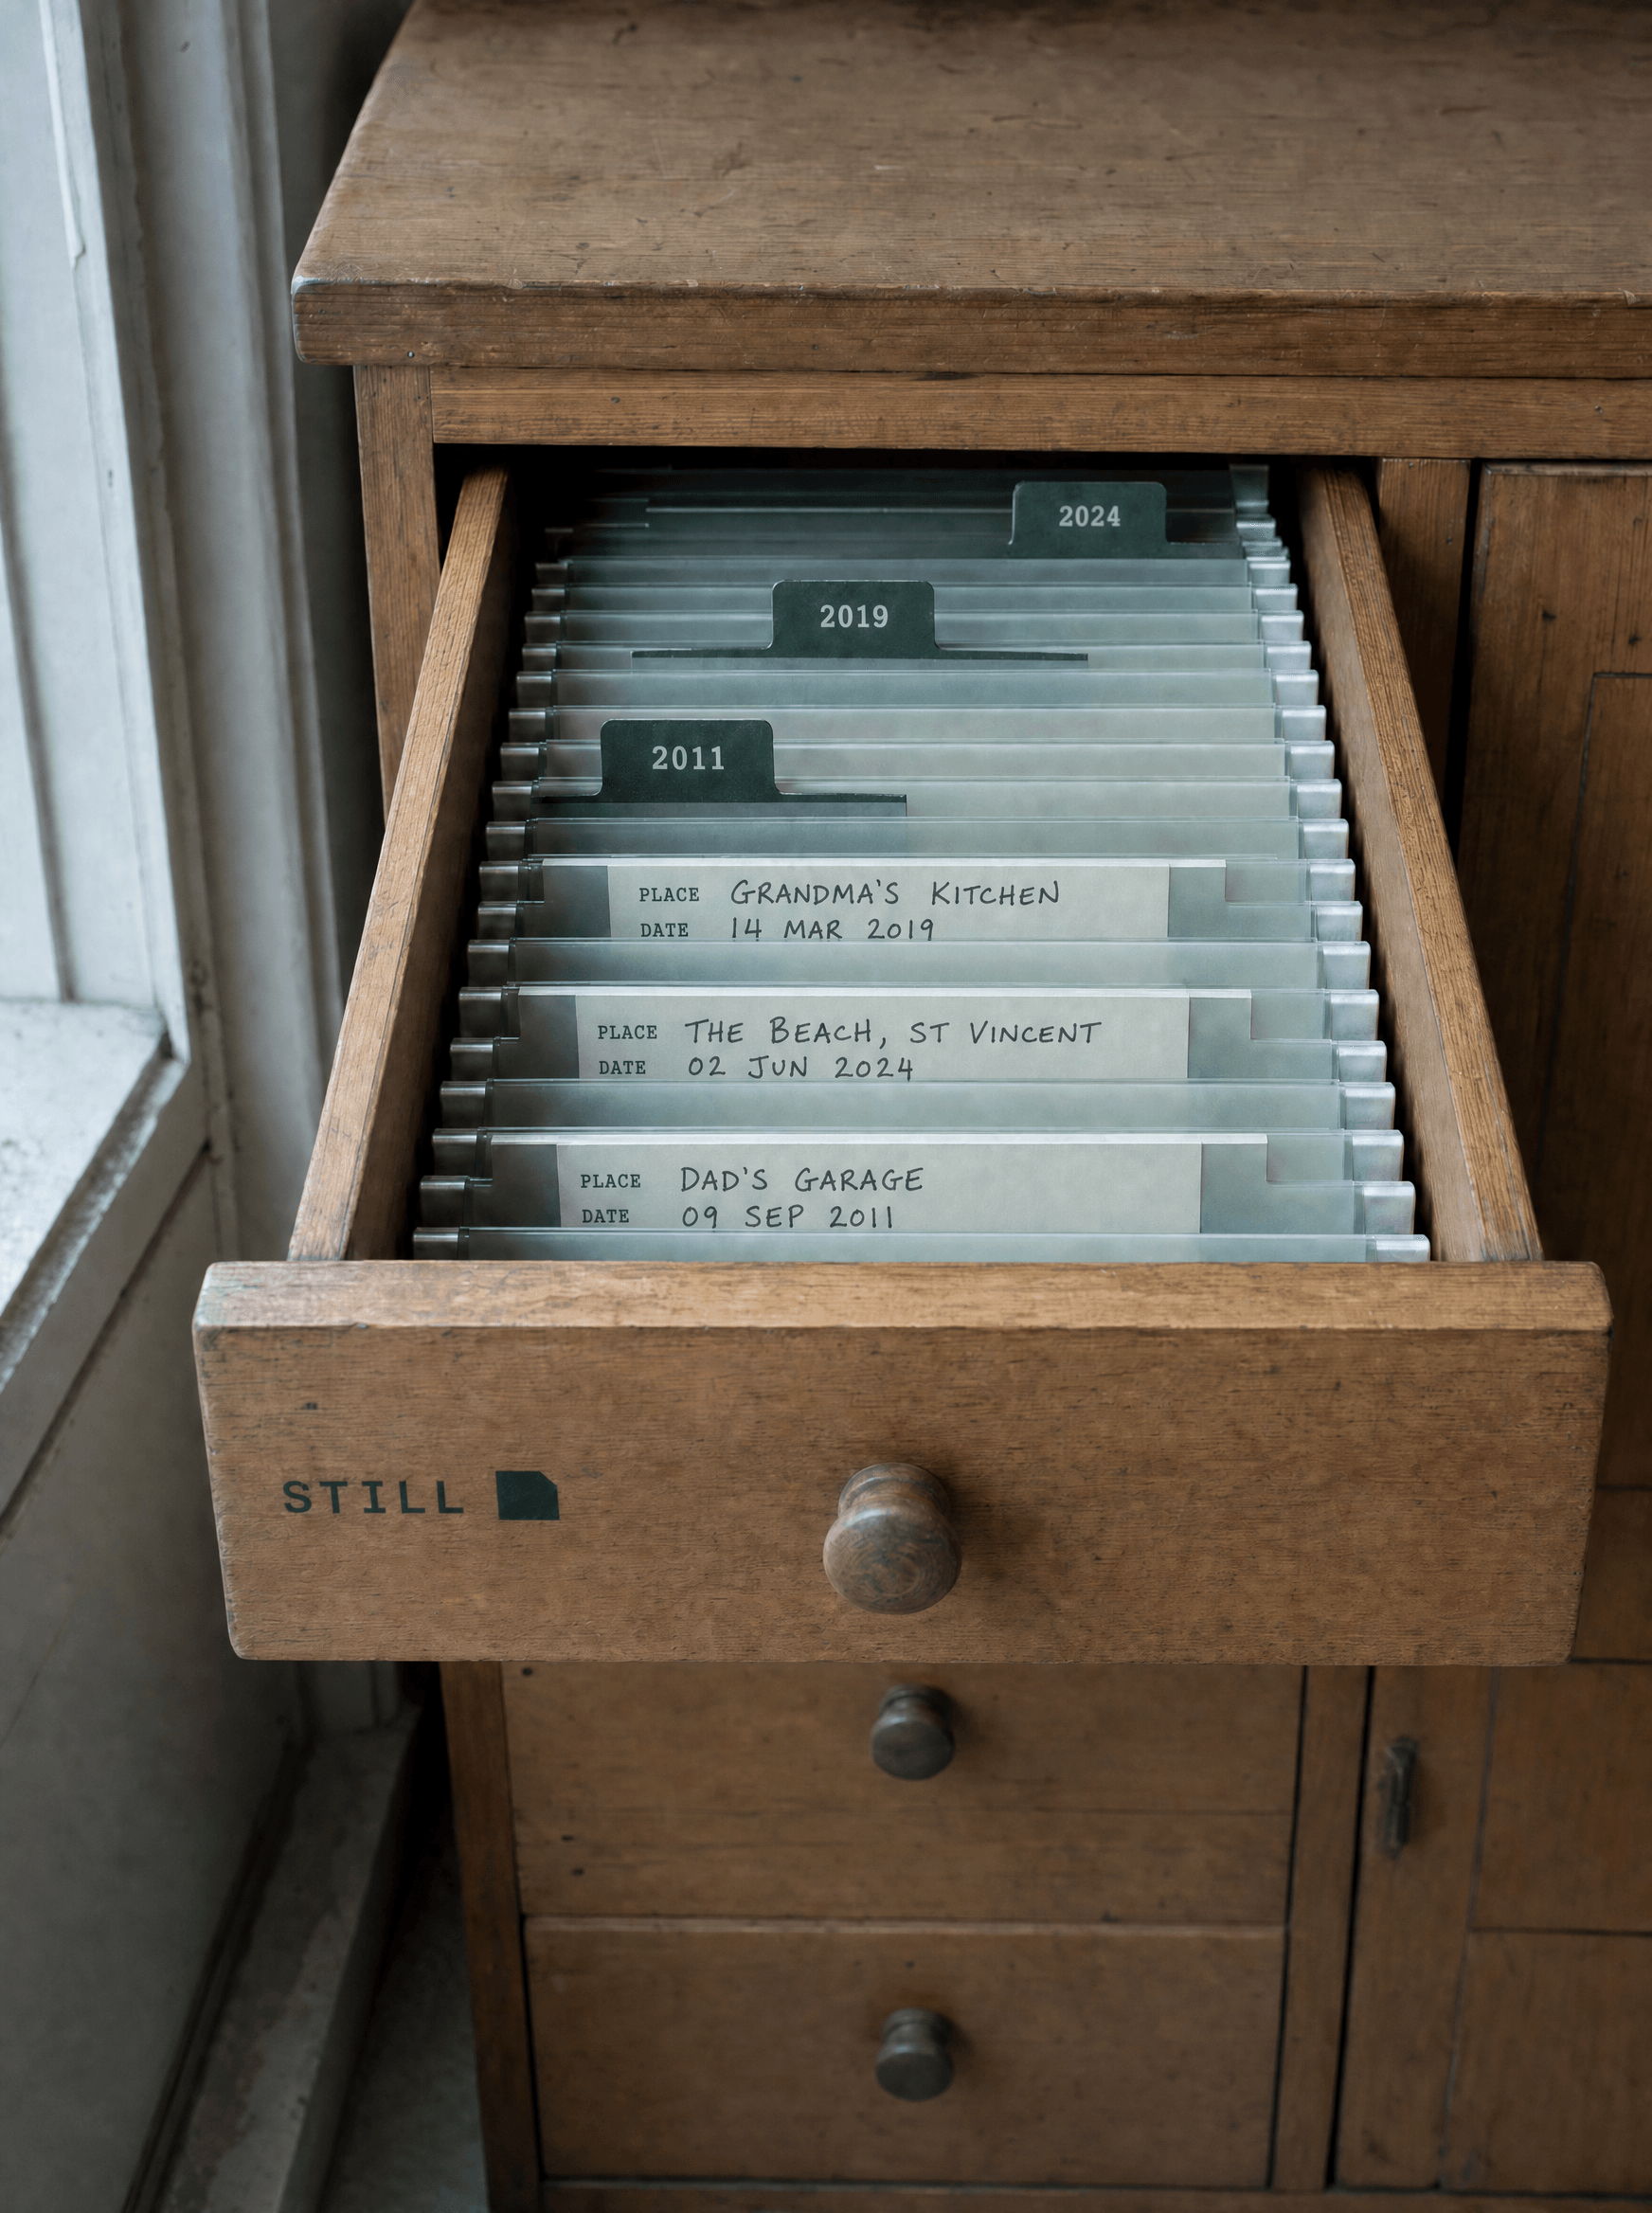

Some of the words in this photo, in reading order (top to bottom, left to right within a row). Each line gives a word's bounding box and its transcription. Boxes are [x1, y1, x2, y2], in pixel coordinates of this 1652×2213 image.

[1058, 505, 1121, 528] 2024
[820, 603, 889, 628] 2019
[652, 745, 725, 771] 2011
[638, 887, 700, 903] PLACE
[730, 878, 899, 906] GRANDMA'S
[931, 880, 1059, 907] KITCHEN
[639, 923, 689, 938] DATE
[731, 916, 763, 941] 14
[783, 919, 843, 941] MAR
[867, 918, 934, 942] 2019
[597, 1024, 657, 1040] PLACE
[684, 1018, 744, 1044] THE
[769, 1016, 887, 1050] BEACH,
[909, 1021, 950, 1044] ST
[969, 1019, 1103, 1045] VINCENT
[599, 1060, 646, 1075] DATE
[688, 1055, 727, 1077] 02
[747, 1054, 808, 1080] JUN
[835, 1056, 913, 1082] 2024
[580, 1173, 641, 1189] PLACE
[680, 1166, 768, 1193] DAD'S
[794, 1167, 924, 1193] GARAGE
[582, 1209, 630, 1224] DATE
[682, 1205, 718, 1231] 09
[745, 1203, 804, 1229] SEP
[829, 1205, 892, 1230] 2011
[282, 1480, 464, 1515] STILL
